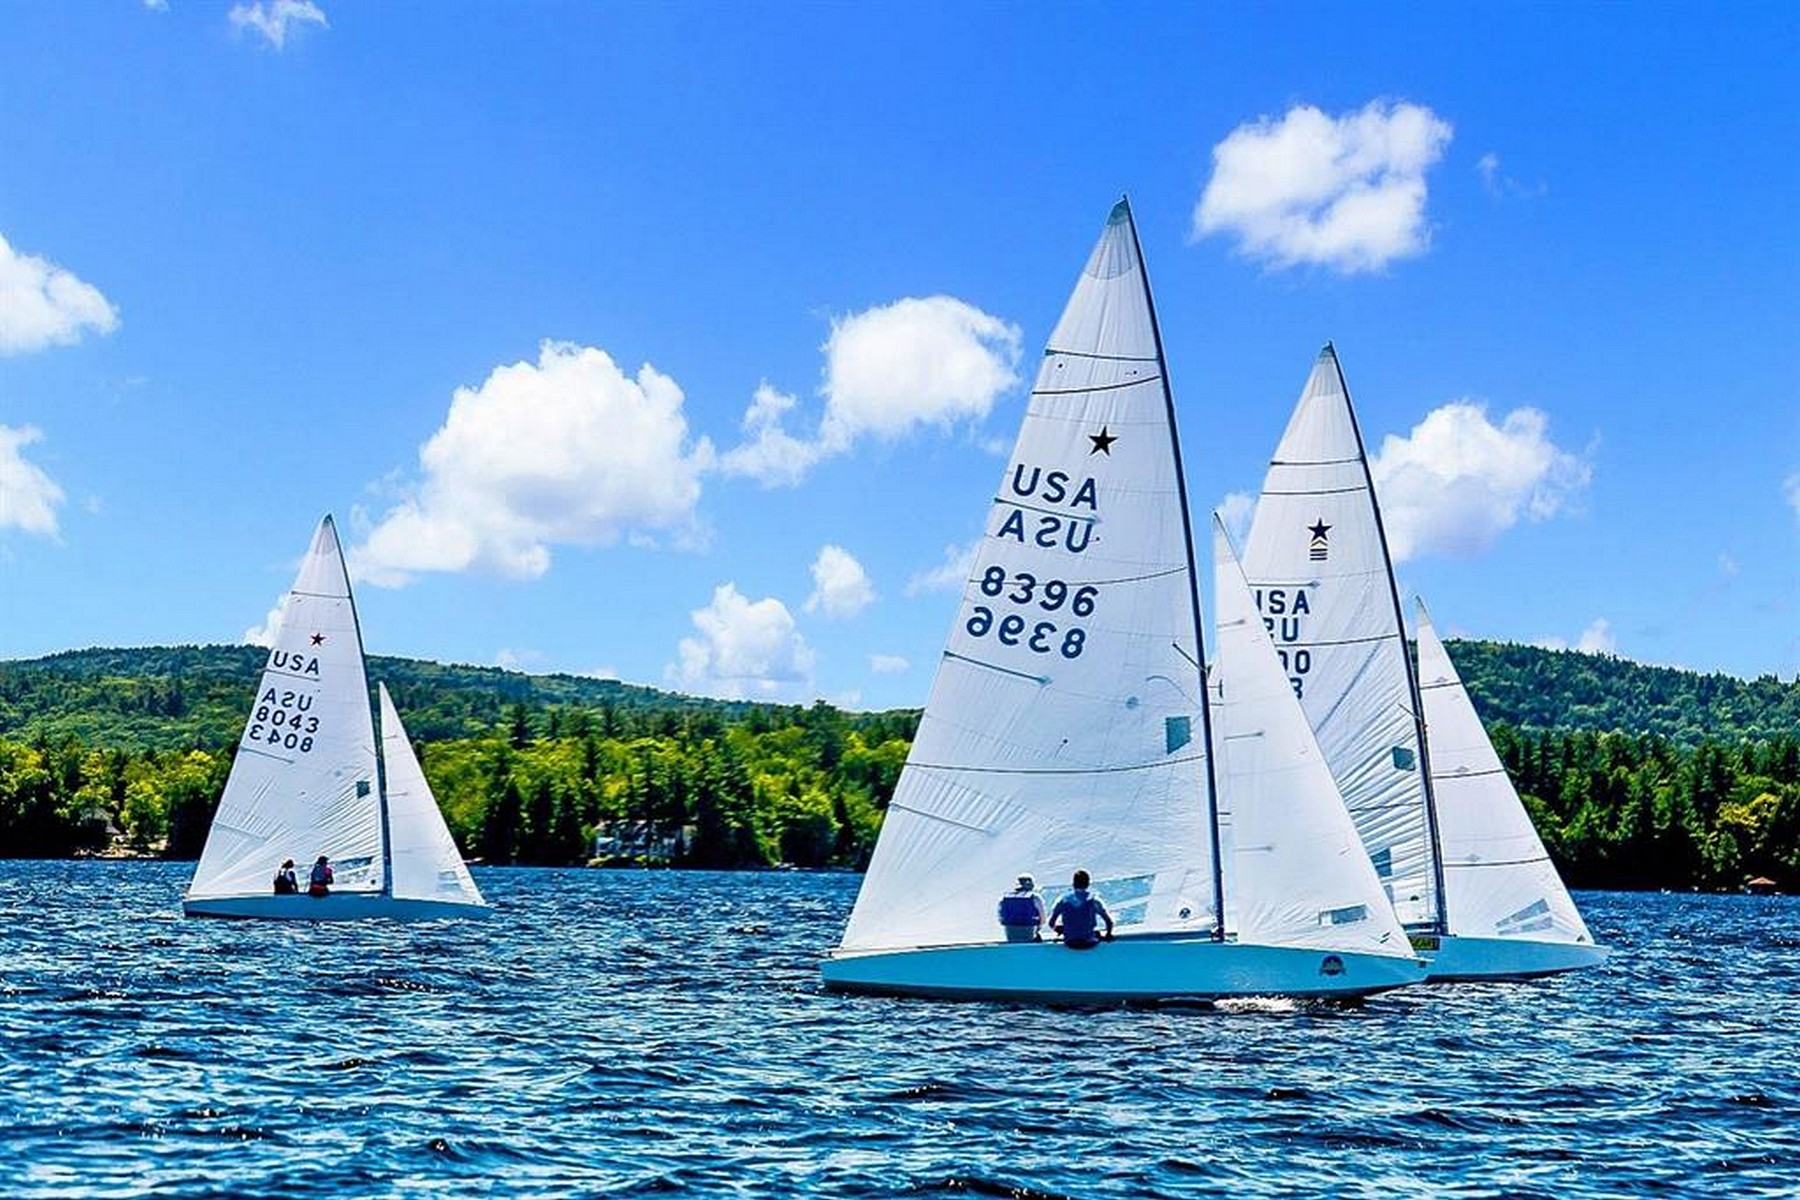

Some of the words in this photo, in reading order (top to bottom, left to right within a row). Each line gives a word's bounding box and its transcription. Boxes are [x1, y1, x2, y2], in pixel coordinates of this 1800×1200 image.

[1012, 464, 1097, 511] USA
[981, 566, 1099, 617] 8396
[273, 650, 319, 675] USA
[256, 706, 319, 733] 8043
